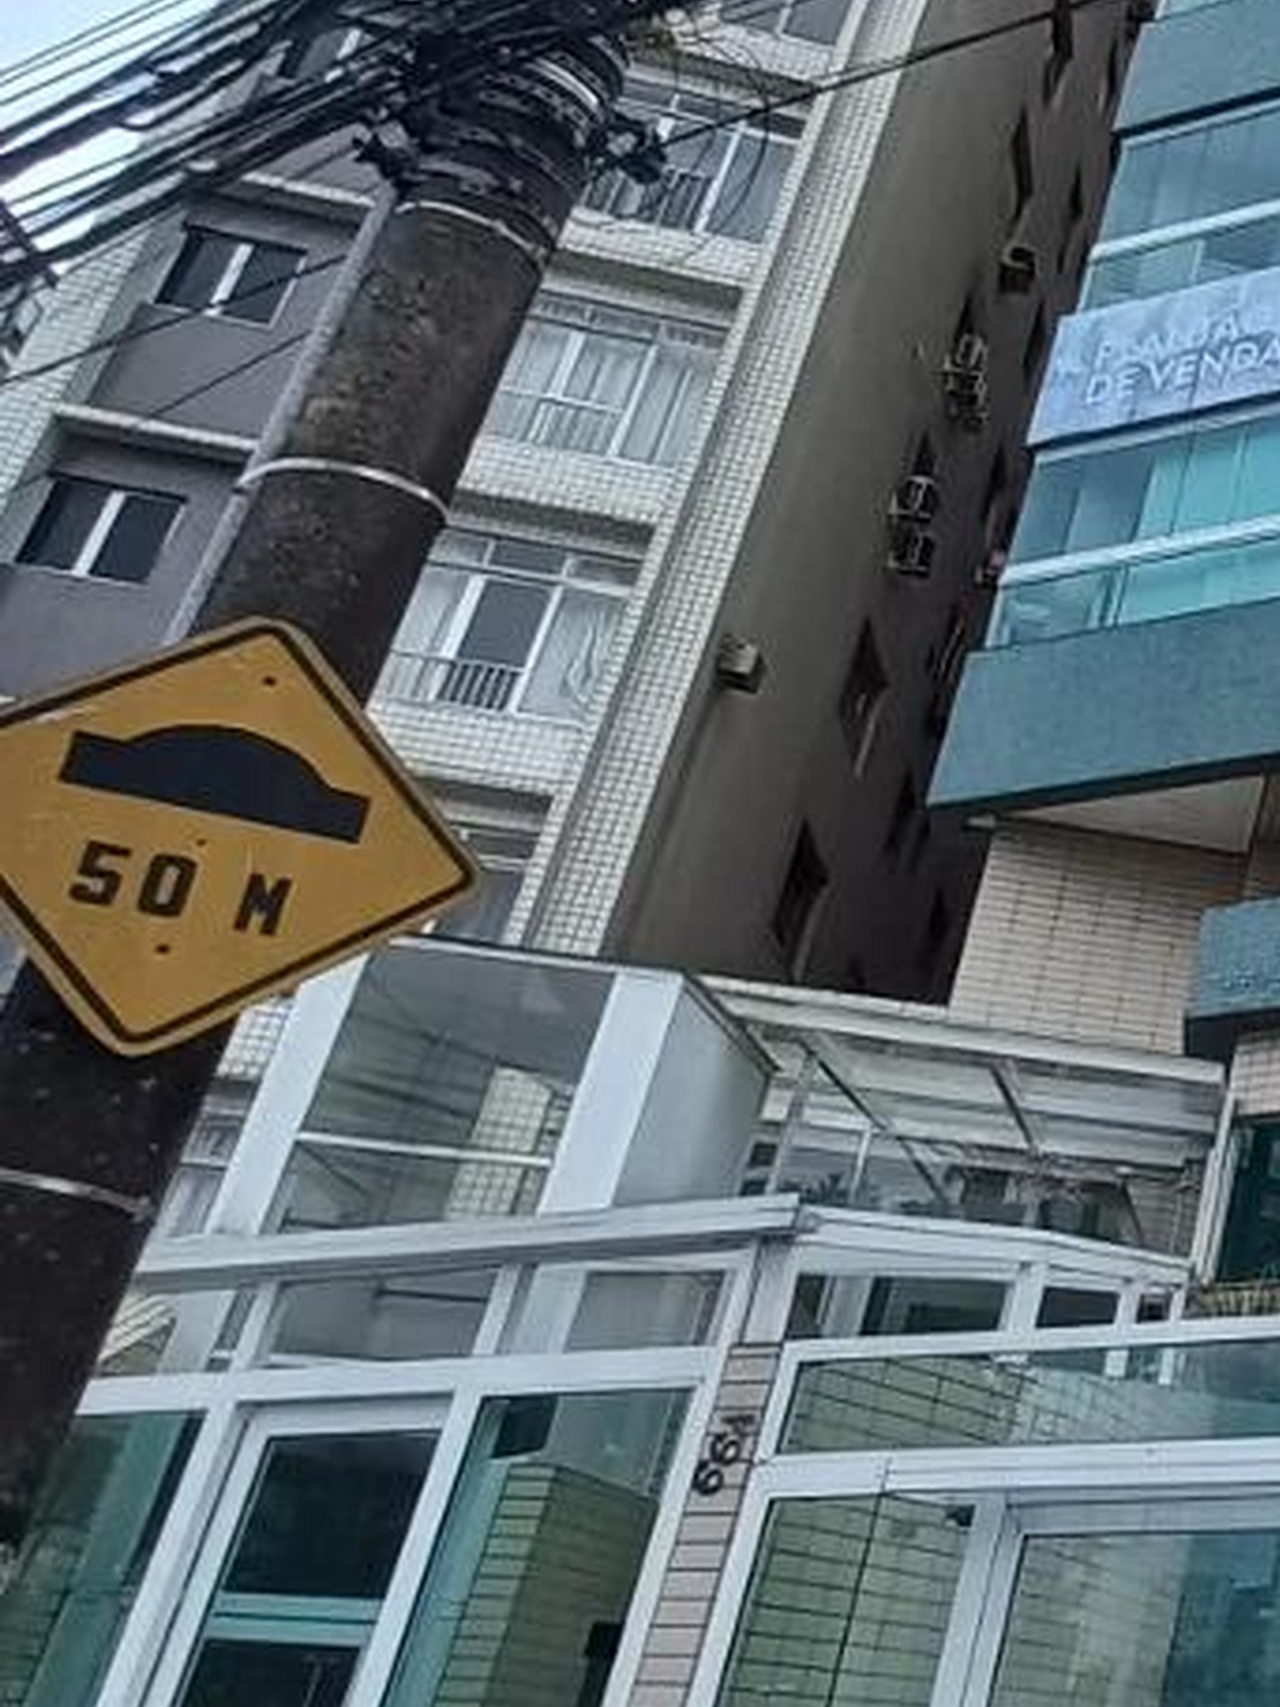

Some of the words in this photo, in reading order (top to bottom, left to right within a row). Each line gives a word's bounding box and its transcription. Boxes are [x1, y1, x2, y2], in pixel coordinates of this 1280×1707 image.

[1086, 364, 1144, 405] DE
[69, 840, 199, 919] 50
[233, 872, 293, 936] M
